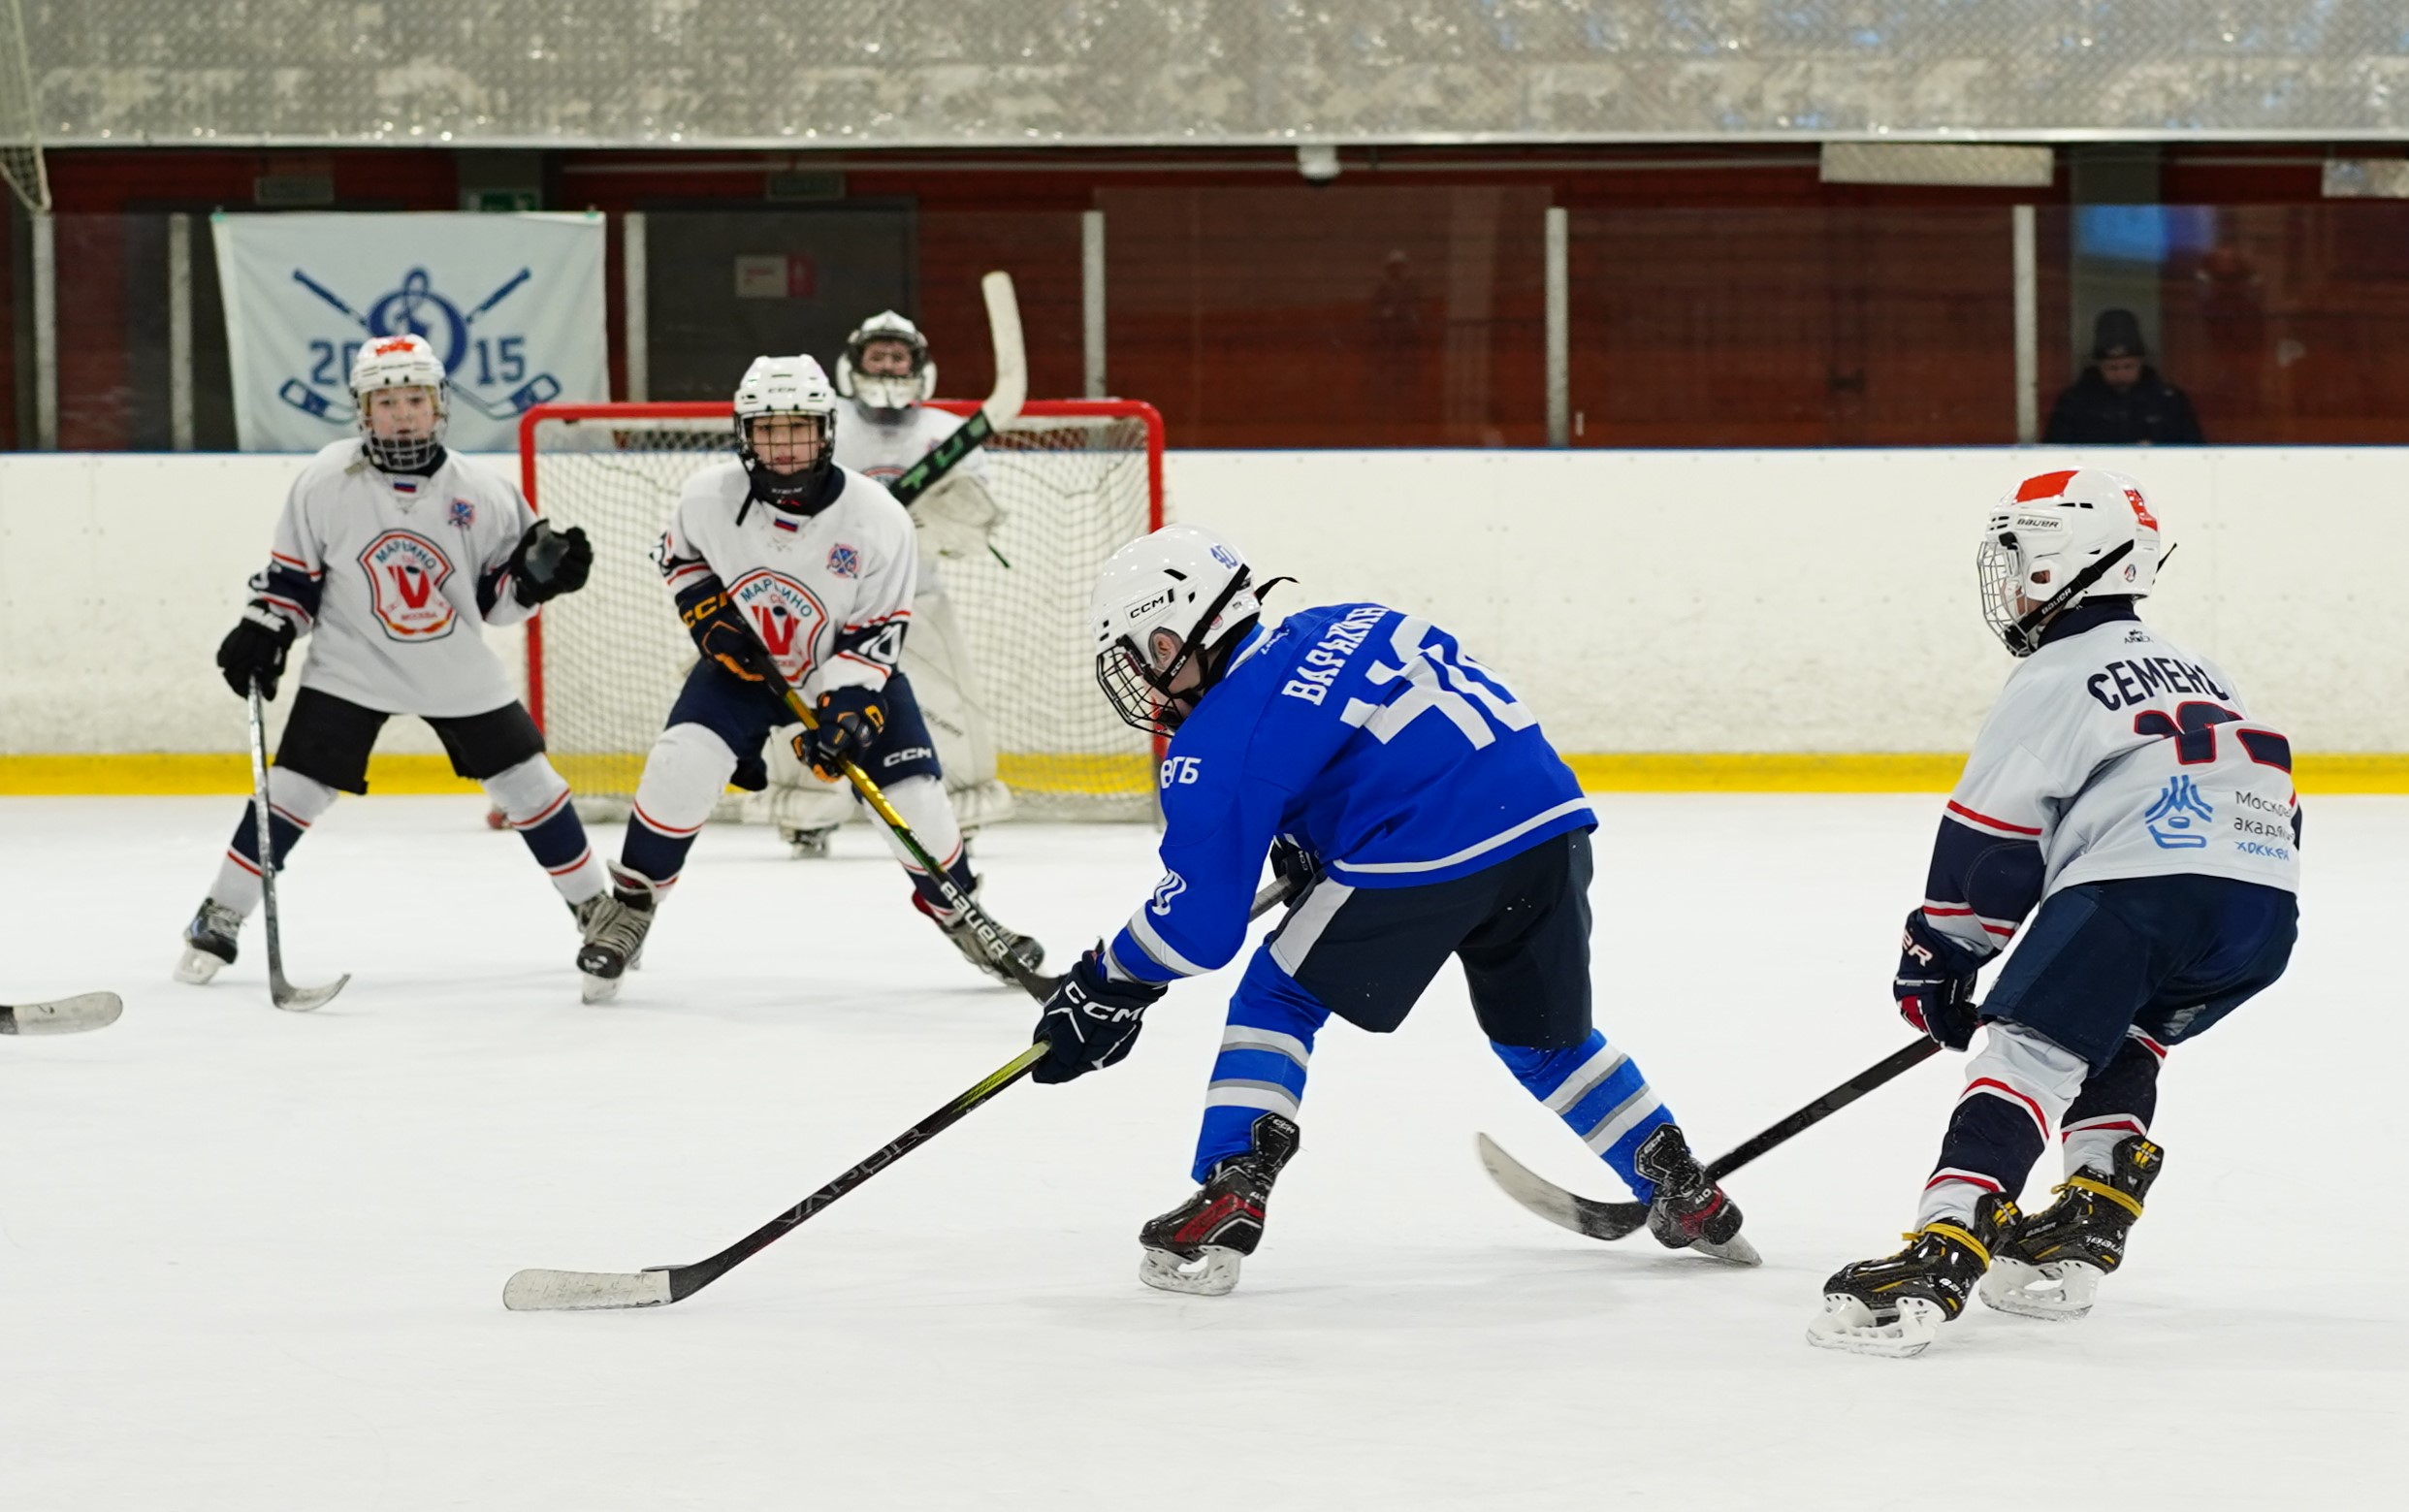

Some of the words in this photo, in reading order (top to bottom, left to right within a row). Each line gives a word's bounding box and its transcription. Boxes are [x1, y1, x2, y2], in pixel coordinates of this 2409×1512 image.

[474, 337, 525, 385] 15
[2017, 517, 2060, 529] BAUER
[1130, 595, 1165, 619] CCM
[2041, 588, 2072, 615] BAUER
[1171, 655, 1187, 676] CCM
[883, 748, 932, 767] CCM
[941, 881, 1010, 959] BAUER
[1065, 981, 1144, 1022] CCM
[1272, 1118, 1296, 1134] CCM
[778, 1127, 933, 1226] VAPOR
[1695, 1188, 1713, 1205] 40
